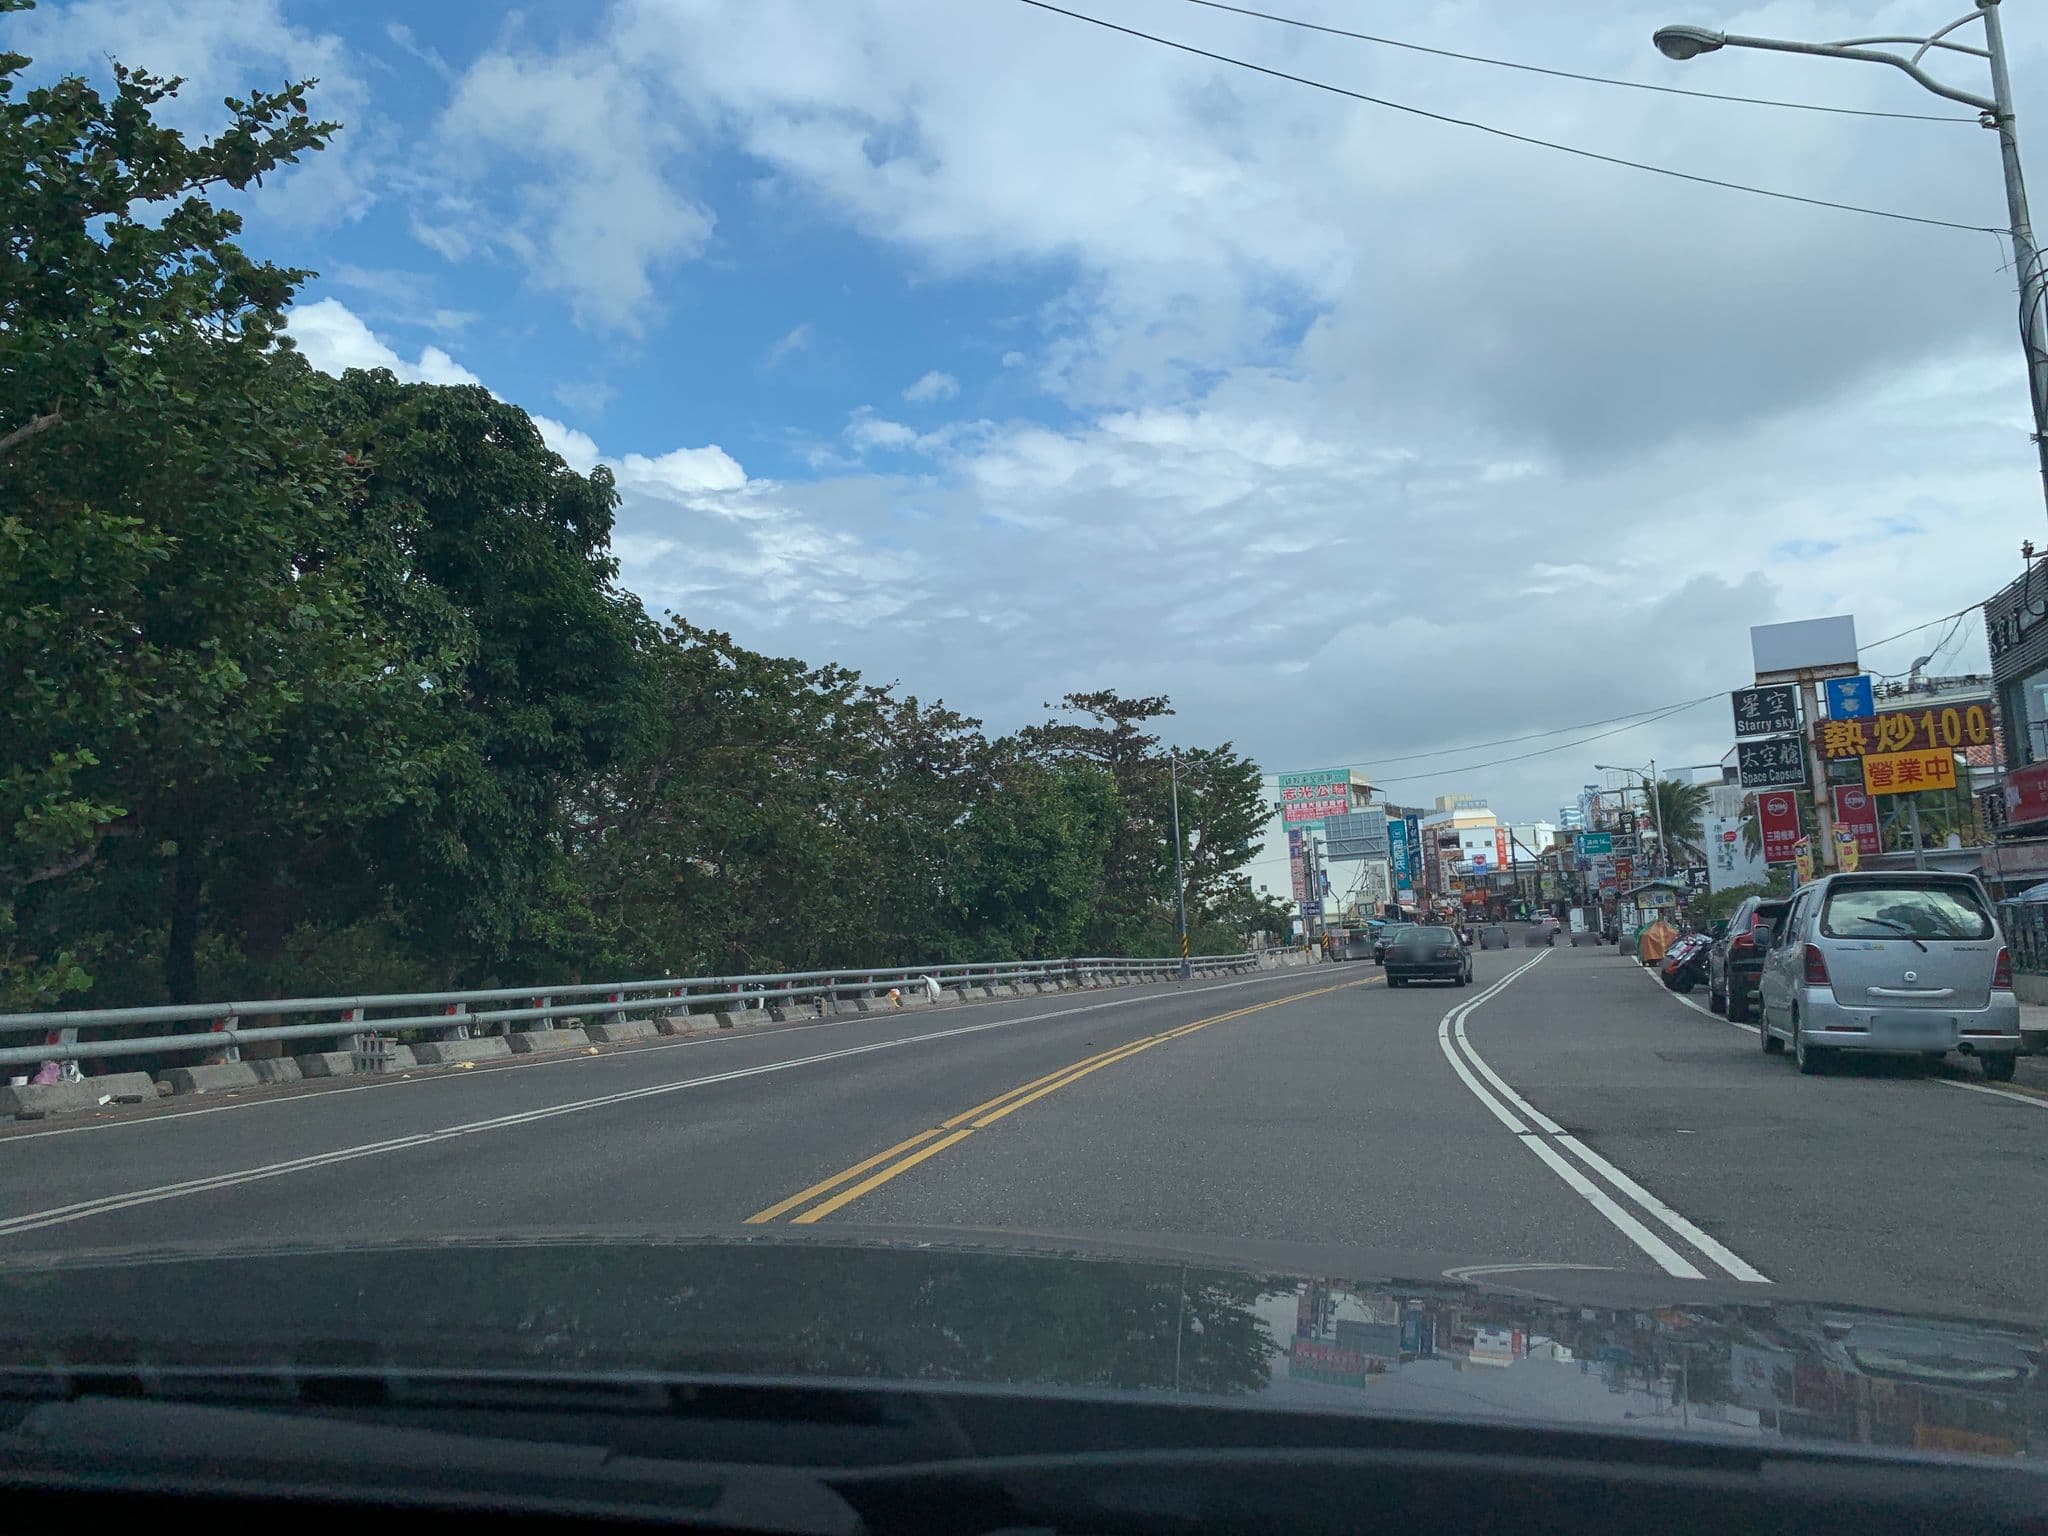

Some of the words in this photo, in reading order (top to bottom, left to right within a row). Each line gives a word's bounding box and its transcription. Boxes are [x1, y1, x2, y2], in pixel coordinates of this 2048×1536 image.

[1740, 691, 1788, 718] 星空
[1737, 721, 1772, 736] Starry
[1775, 717, 1796, 735] sky
[1823, 705, 1987, 757] 熱炒100
[1742, 771, 1767, 787] Space
[1769, 768, 1803, 785] Capsule
[1867, 755, 1951, 788] 營業中
